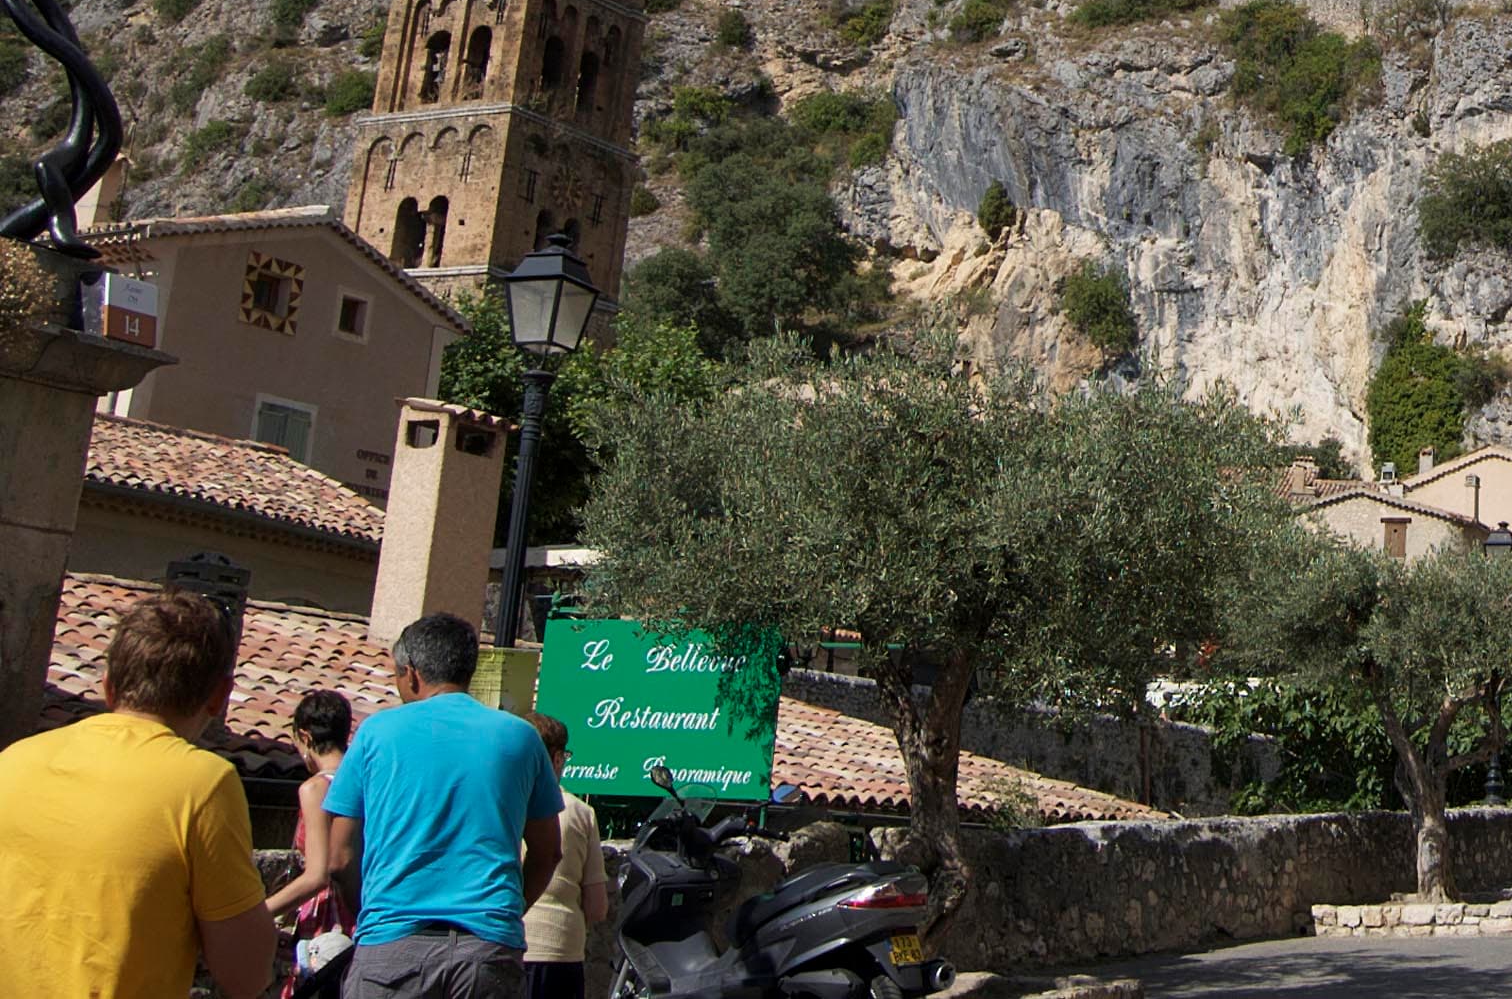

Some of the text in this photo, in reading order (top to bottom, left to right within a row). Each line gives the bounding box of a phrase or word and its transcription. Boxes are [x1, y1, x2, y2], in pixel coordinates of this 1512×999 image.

[125, 314, 139, 338] 14
[356, 448, 390, 465] OFFICE
[581, 639, 747, 673] Le Bellevue
[587, 696, 720, 729] Restaurant
[562, 755, 752, 791] errasse Pnoramique
